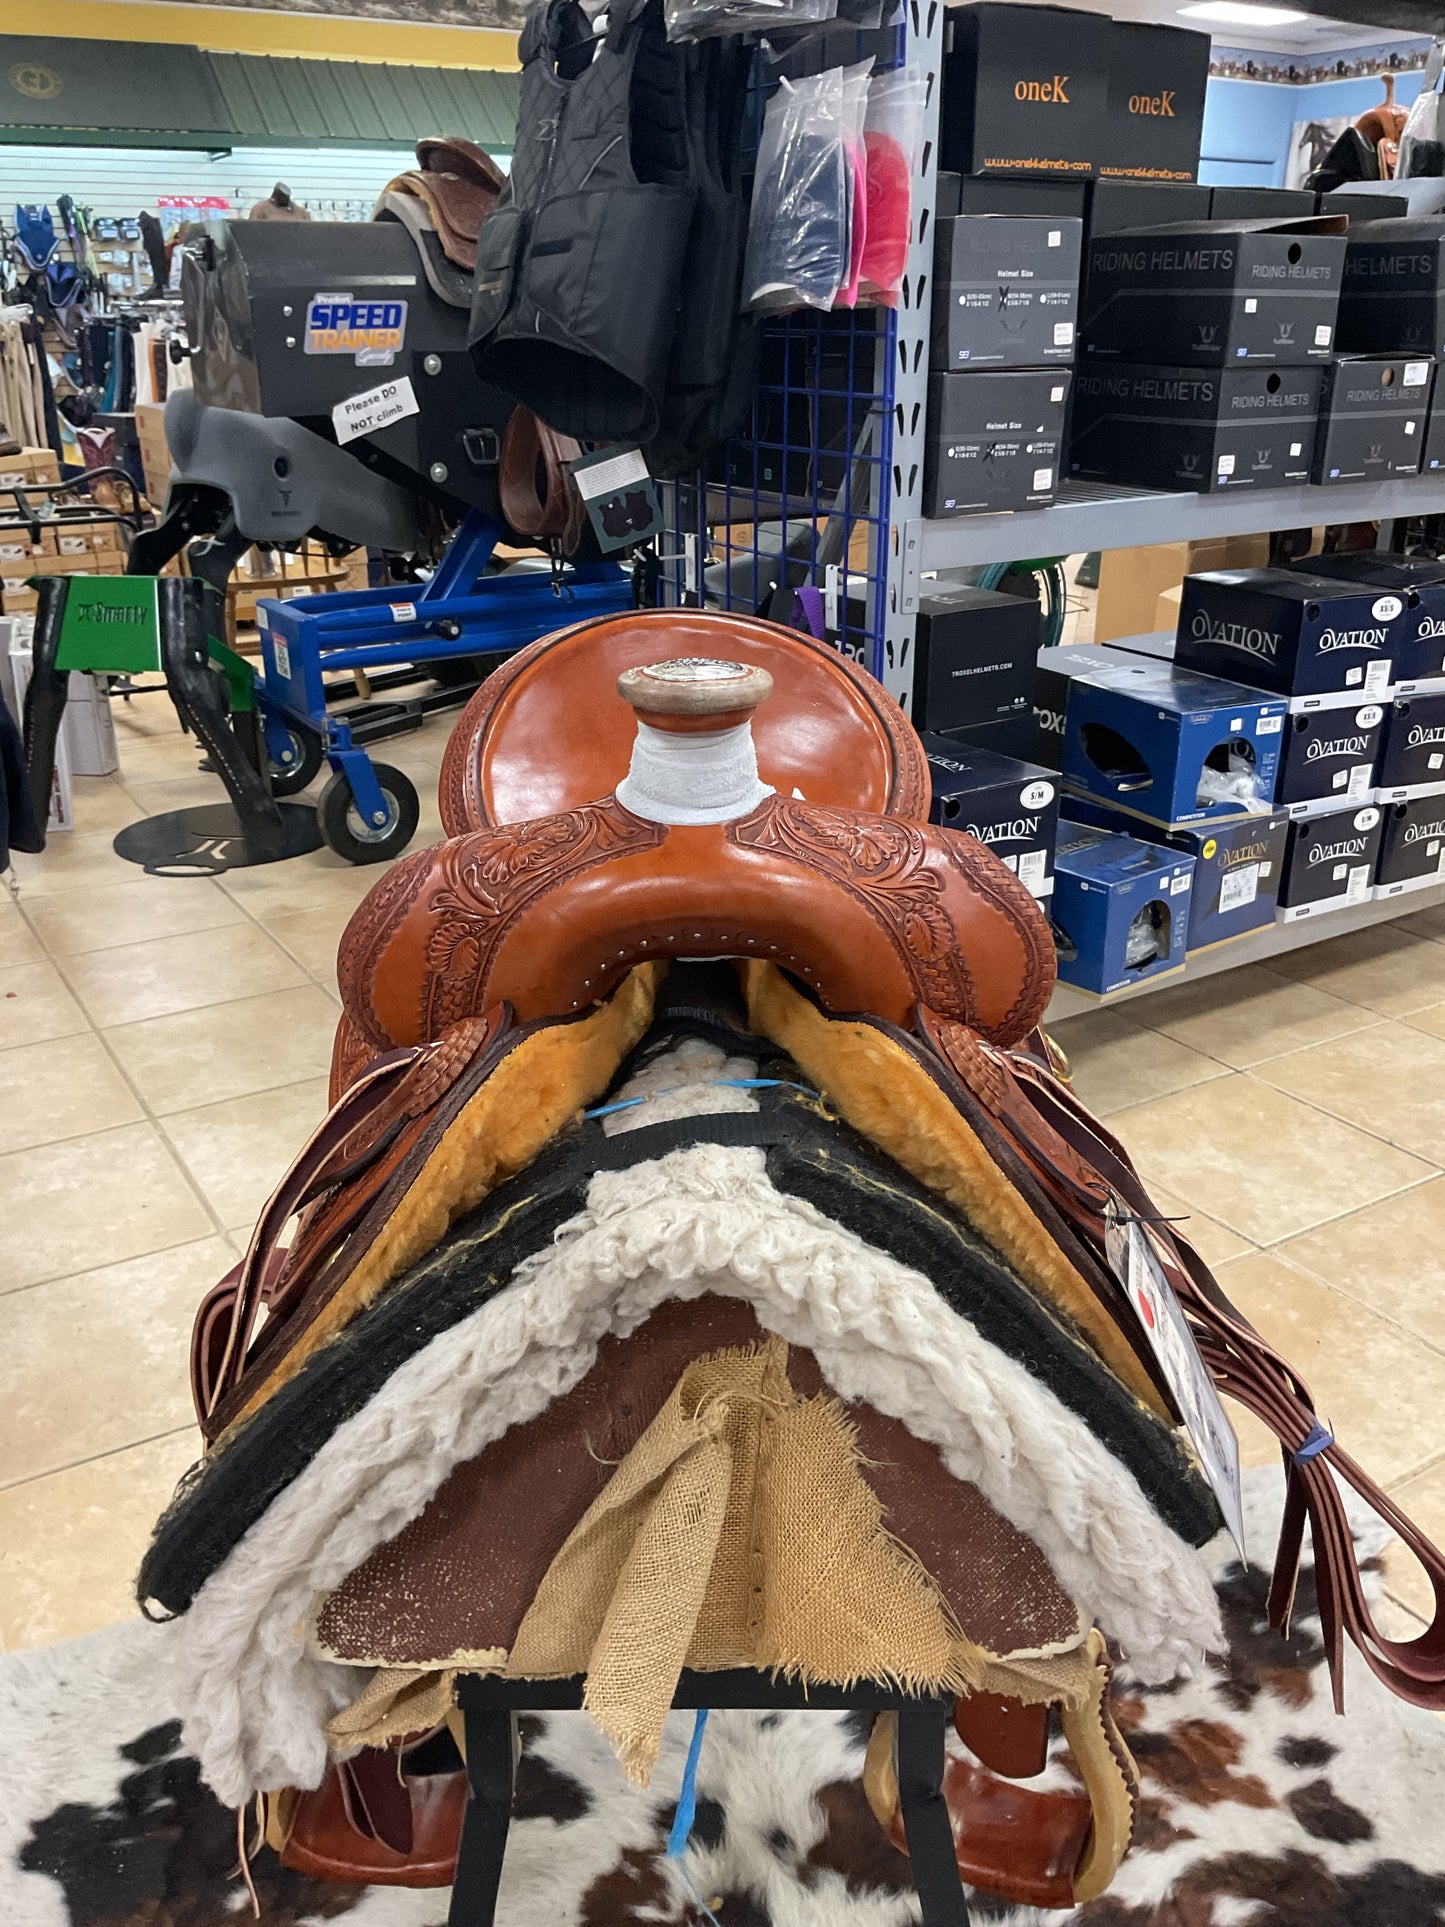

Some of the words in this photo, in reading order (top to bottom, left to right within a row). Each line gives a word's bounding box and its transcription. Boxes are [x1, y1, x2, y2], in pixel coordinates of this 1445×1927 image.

[1014, 75, 1070, 103] oneK
[1128, 90, 1176, 117] oneK
[1151, 249, 1234, 271] HELMETS
[997, 269, 1019, 278] Helmet
[1020, 269, 1034, 278] Size
[1252, 265, 1286, 279] RIDING
[1288, 265, 1331, 280] HELMETS
[310, 304, 403, 330] SPEED
[309, 329, 401, 349] TRAINER
[345, 394, 380, 414] Please
[382, 385, 397, 399] DO
[1132, 380, 1213, 402] HELMETS
[1231, 395, 1265, 409] RIDING
[1266, 393, 1310, 408] HELMETS
[1347, 389, 1380, 402] RIDING
[1381, 387, 1421, 401] HELMETS
[350, 416, 374, 432] NOT
[377, 404, 404, 422] climb
[986, 422, 1008, 430] Helmet
[1009, 421, 1022, 430] Size
[1192, 608, 1279, 656] OVATION
[1319, 628, 1388, 651] OVATION
[952, 662, 1013, 678] TROXELHELMETS.COM
[1306, 734, 1370, 760] OVATION
[1030, 791, 1044, 801] S/M
[1217, 841, 1268, 868] OVATION
[1308, 836, 1368, 864] OVATION
